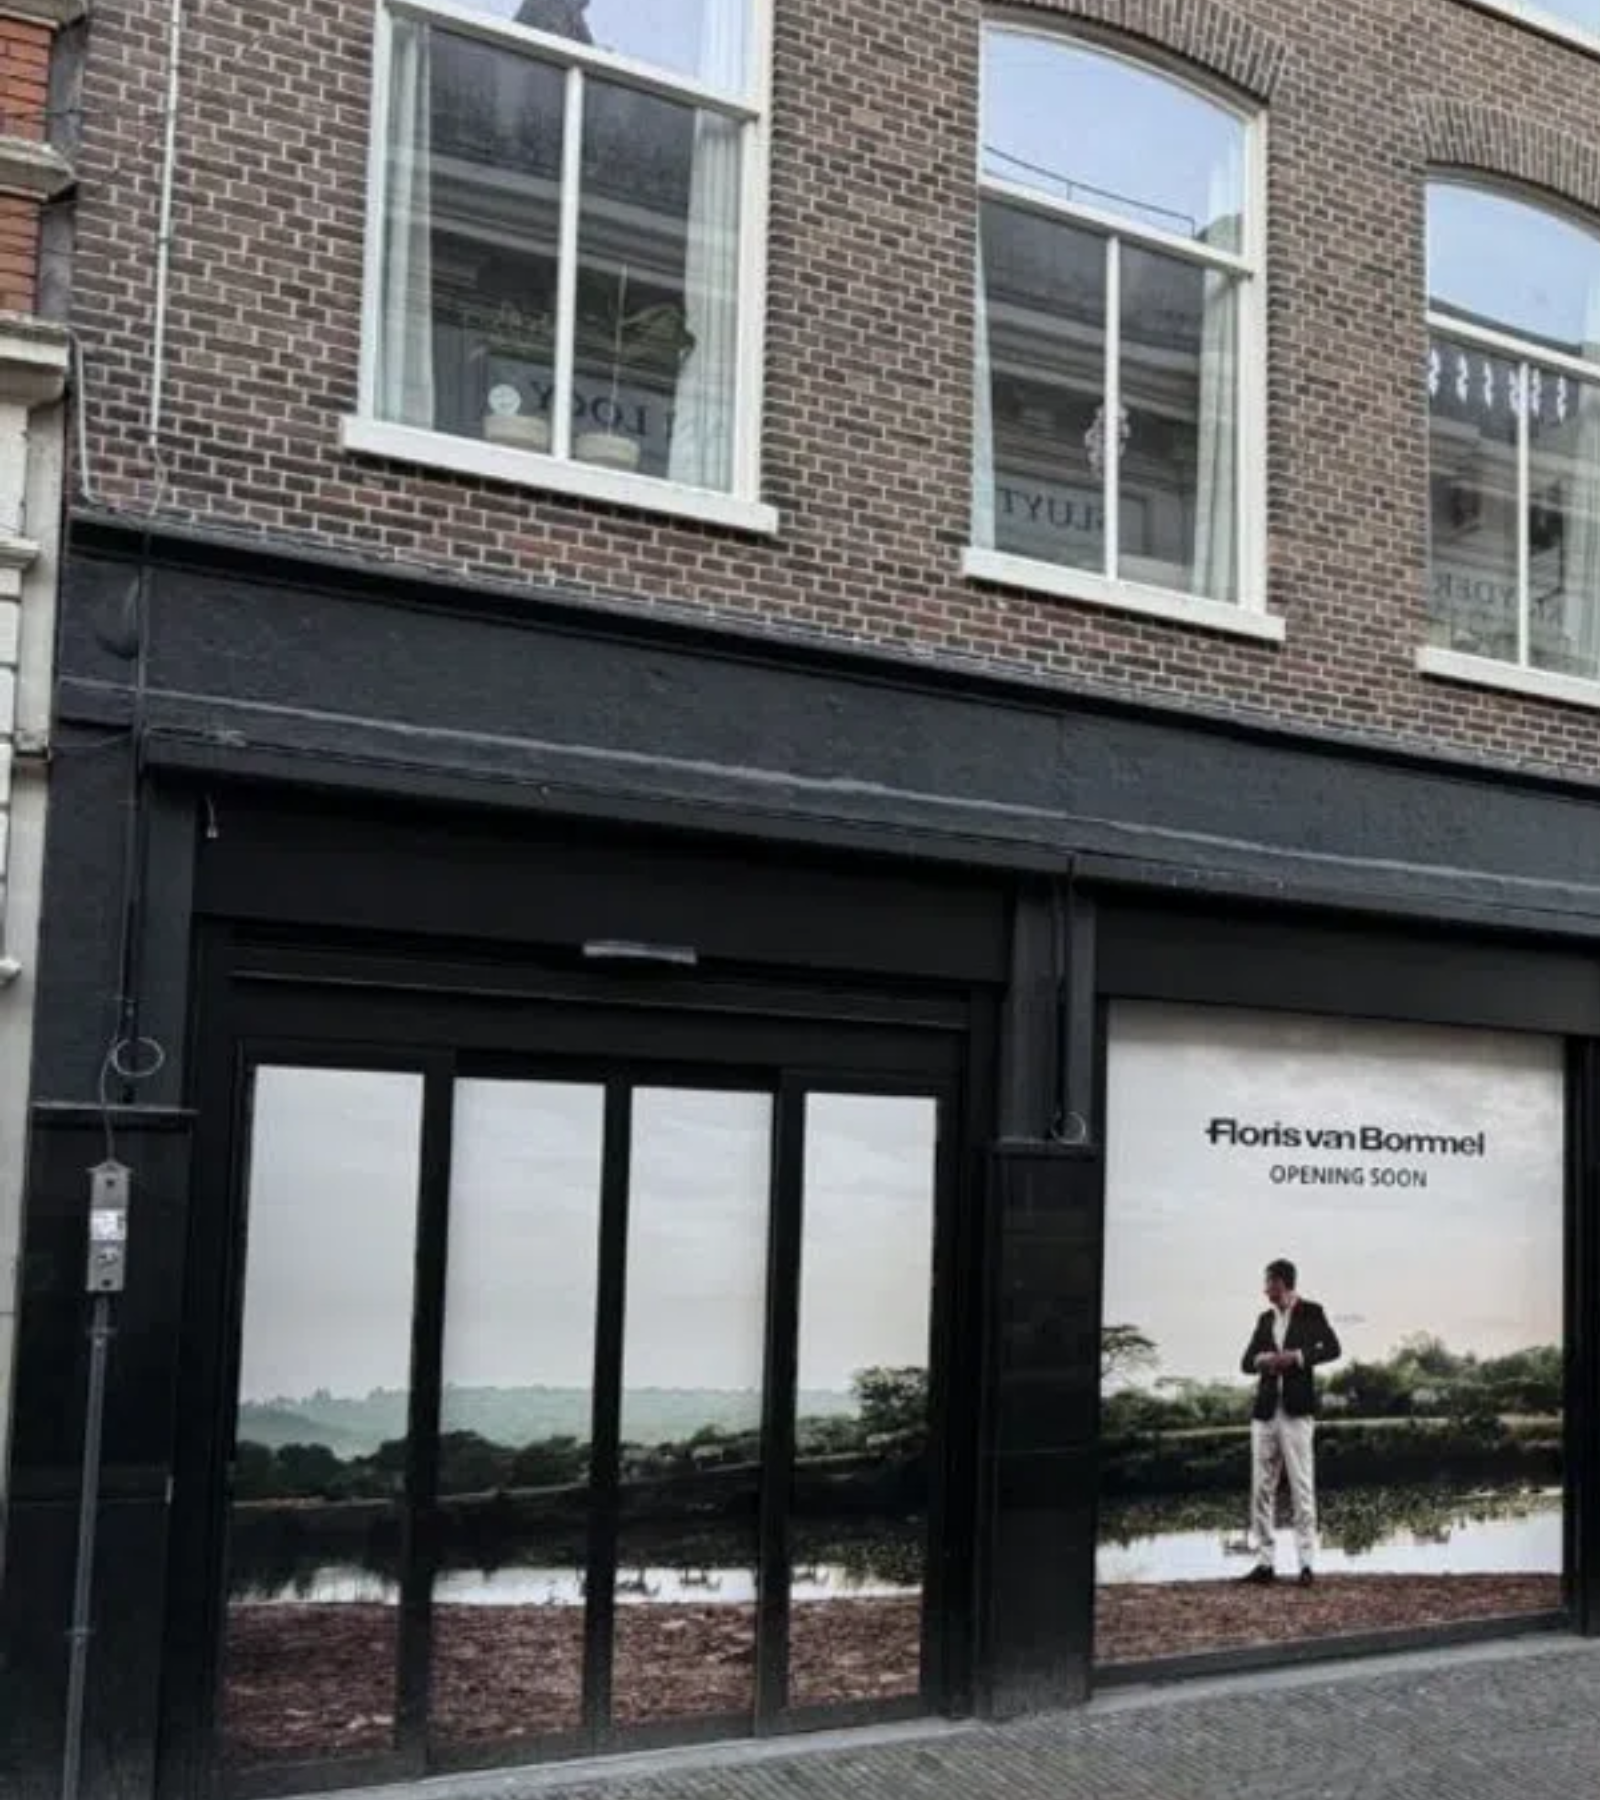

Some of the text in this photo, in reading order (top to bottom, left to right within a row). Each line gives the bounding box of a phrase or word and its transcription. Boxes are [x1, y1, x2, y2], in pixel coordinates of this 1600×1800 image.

[1205, 1117, 1485, 1156] Floris van Bommel
[1269, 1164, 1427, 1188] OPENING SOON
